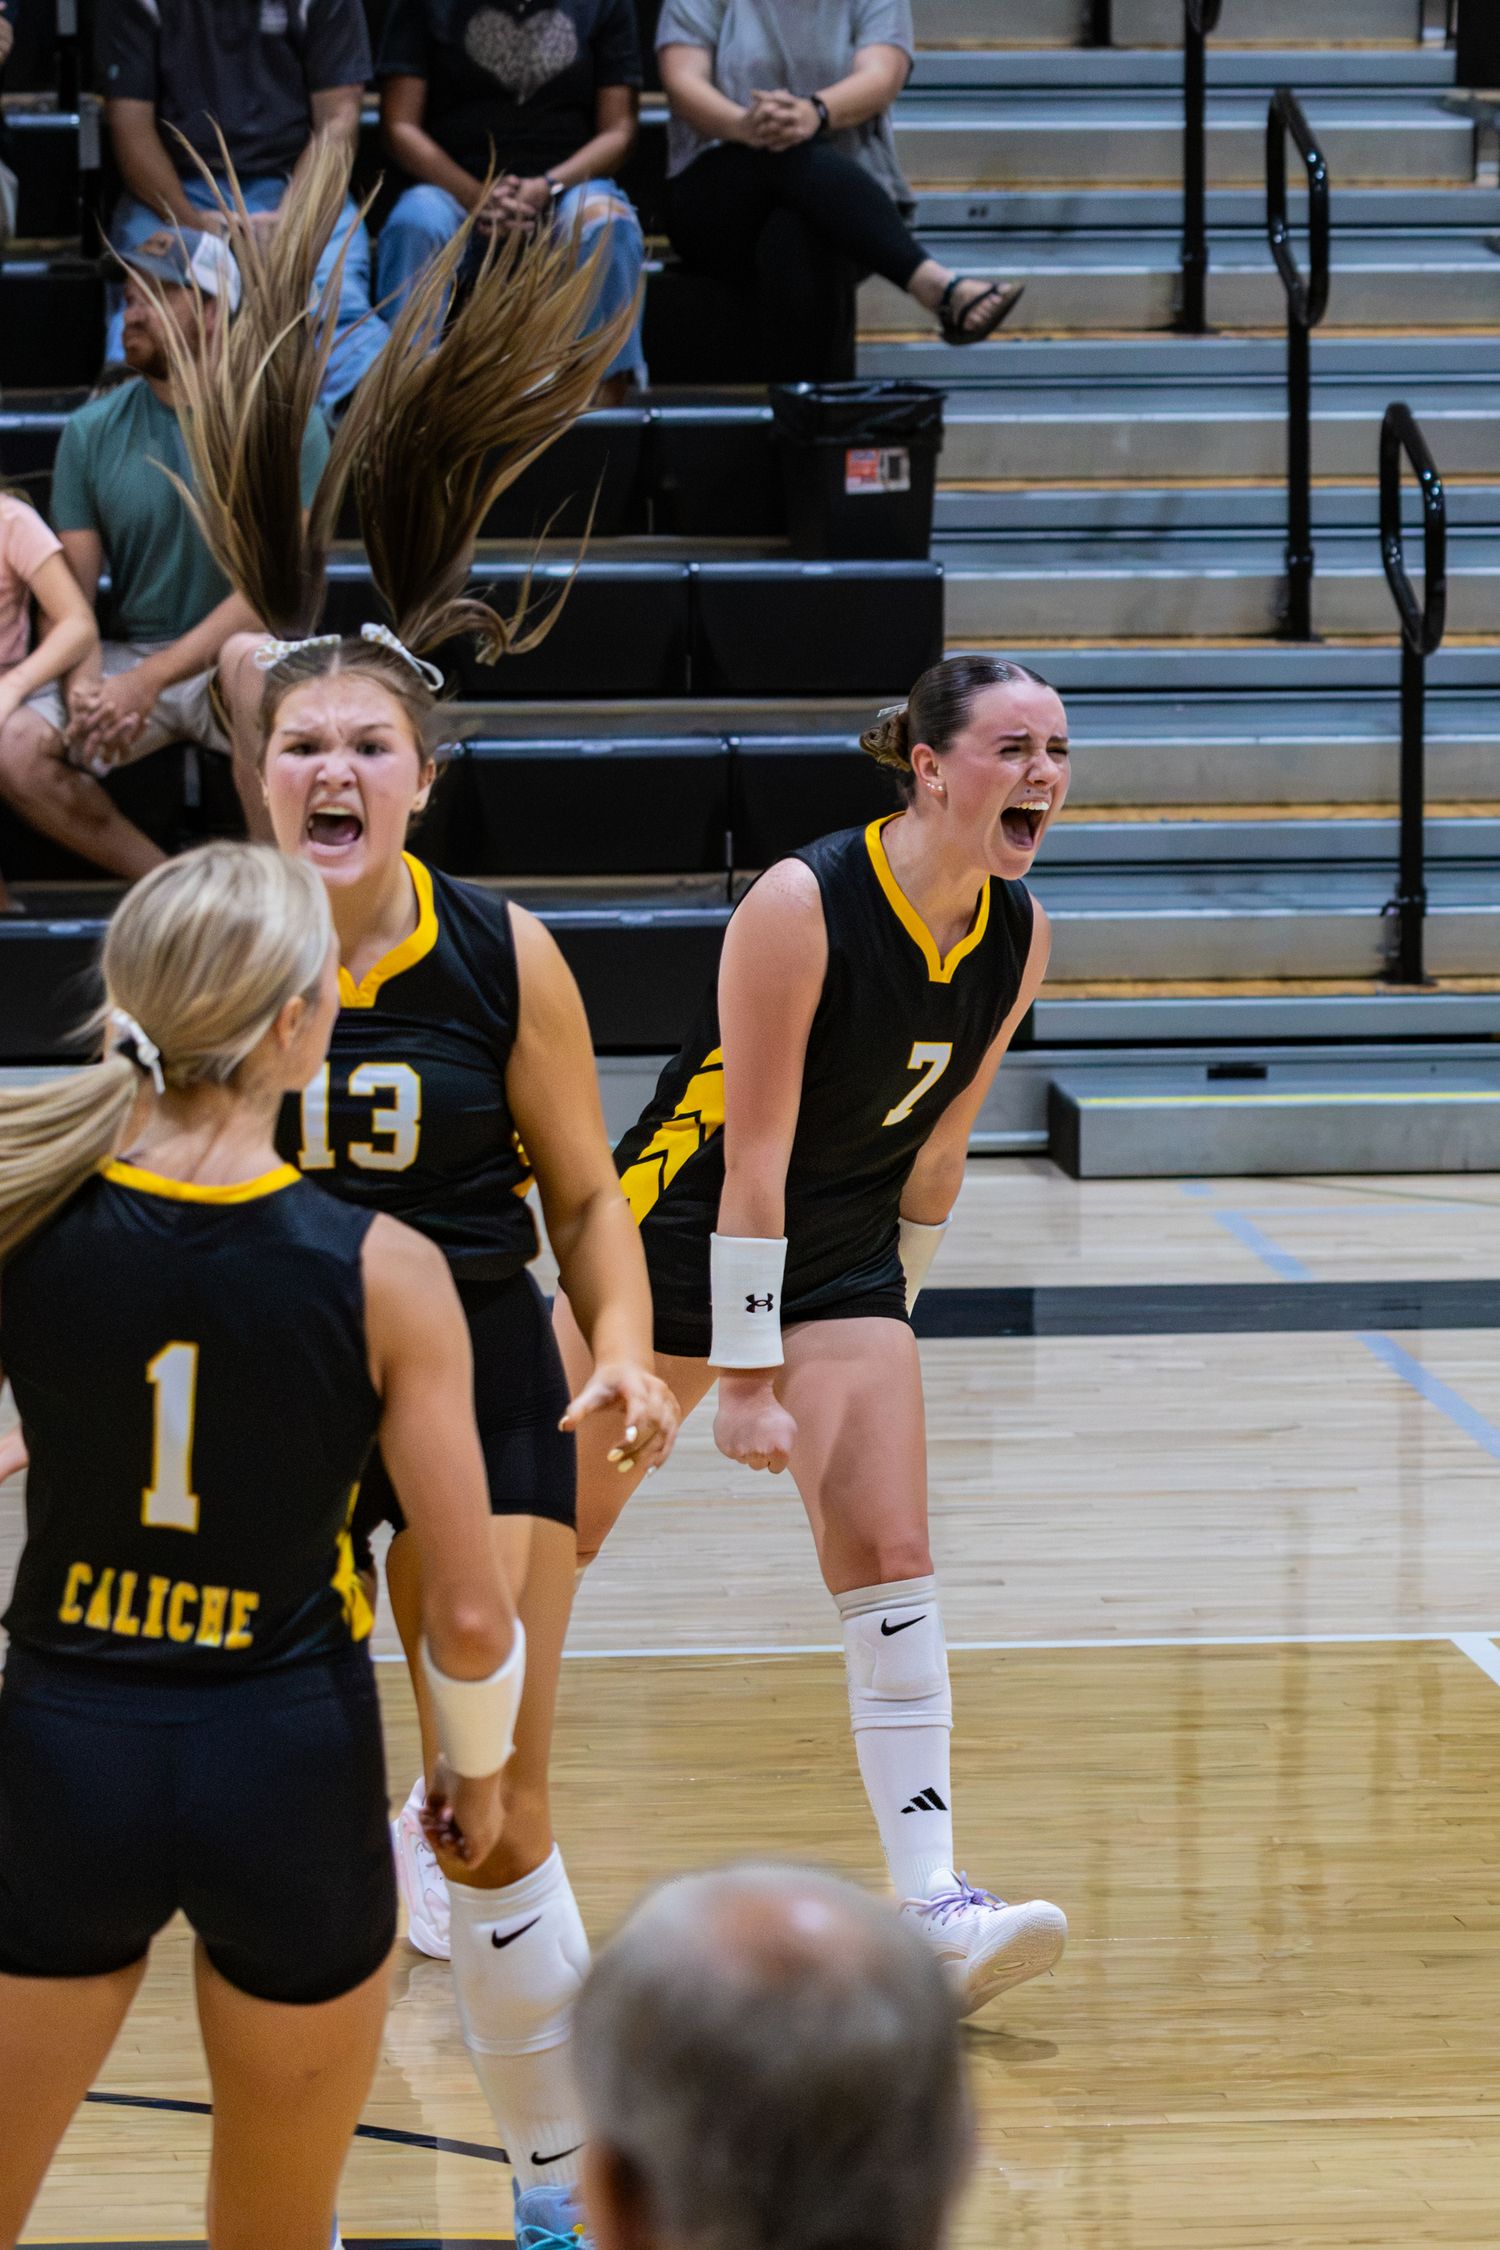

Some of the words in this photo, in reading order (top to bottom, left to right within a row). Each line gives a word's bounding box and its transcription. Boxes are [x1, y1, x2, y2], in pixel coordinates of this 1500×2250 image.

[297, 1061, 422, 1172] 13
[881, 1040, 954, 1127] 7
[140, 1339, 200, 1534] 1
[58, 1561, 260, 1650] CALICHE
